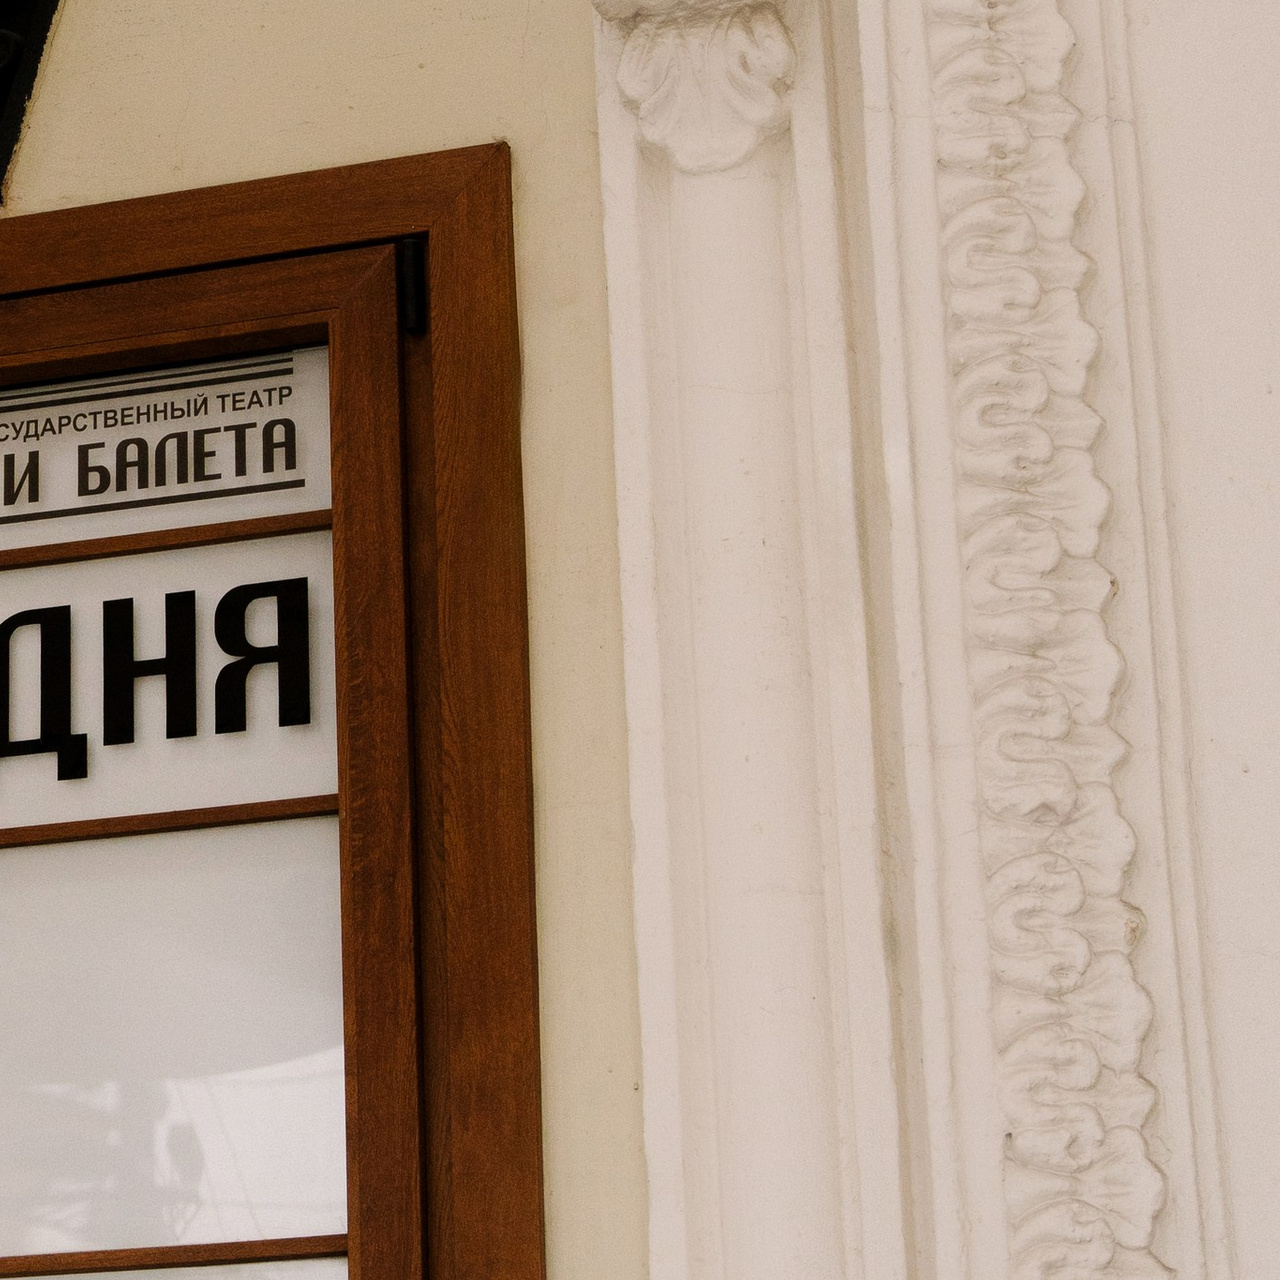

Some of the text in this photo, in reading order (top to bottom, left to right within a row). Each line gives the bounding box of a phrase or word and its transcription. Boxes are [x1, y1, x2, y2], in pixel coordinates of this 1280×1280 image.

[216, 385, 294, 414] ТЕАТР
[3, 450, 40, 507] И
[76, 417, 297, 497] БАЛЕТА
